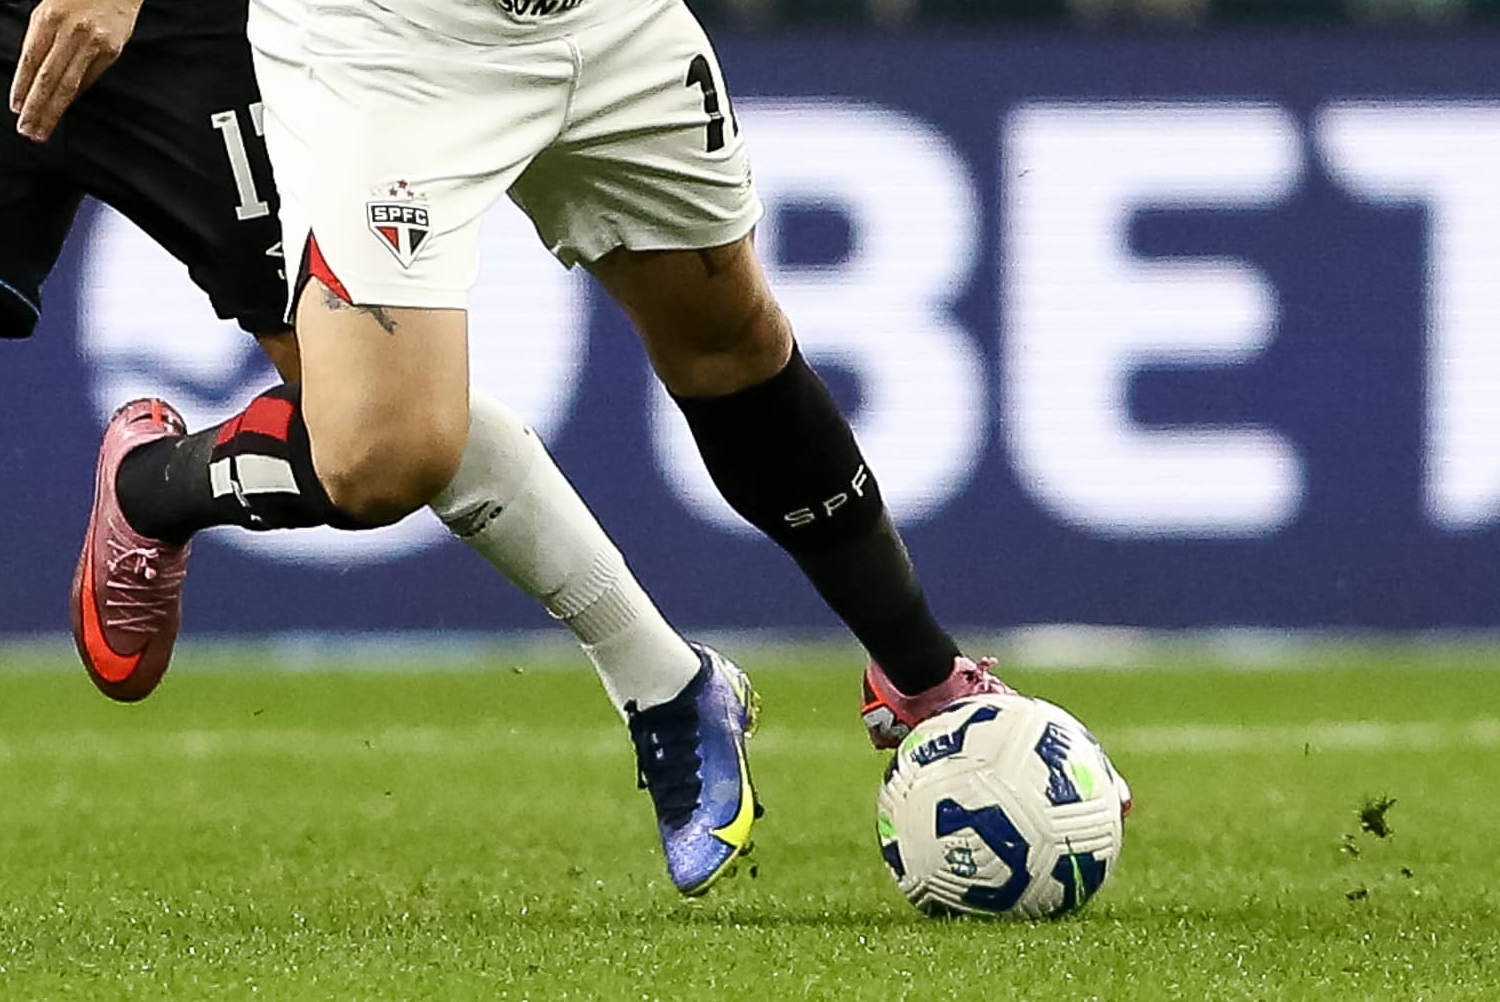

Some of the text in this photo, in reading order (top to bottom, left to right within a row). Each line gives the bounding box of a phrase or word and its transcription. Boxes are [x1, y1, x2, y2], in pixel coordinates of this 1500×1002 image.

[685, 53, 738, 153] 1
[211, 101, 270, 220] 1
[374, 205, 427, 225] SPFC
